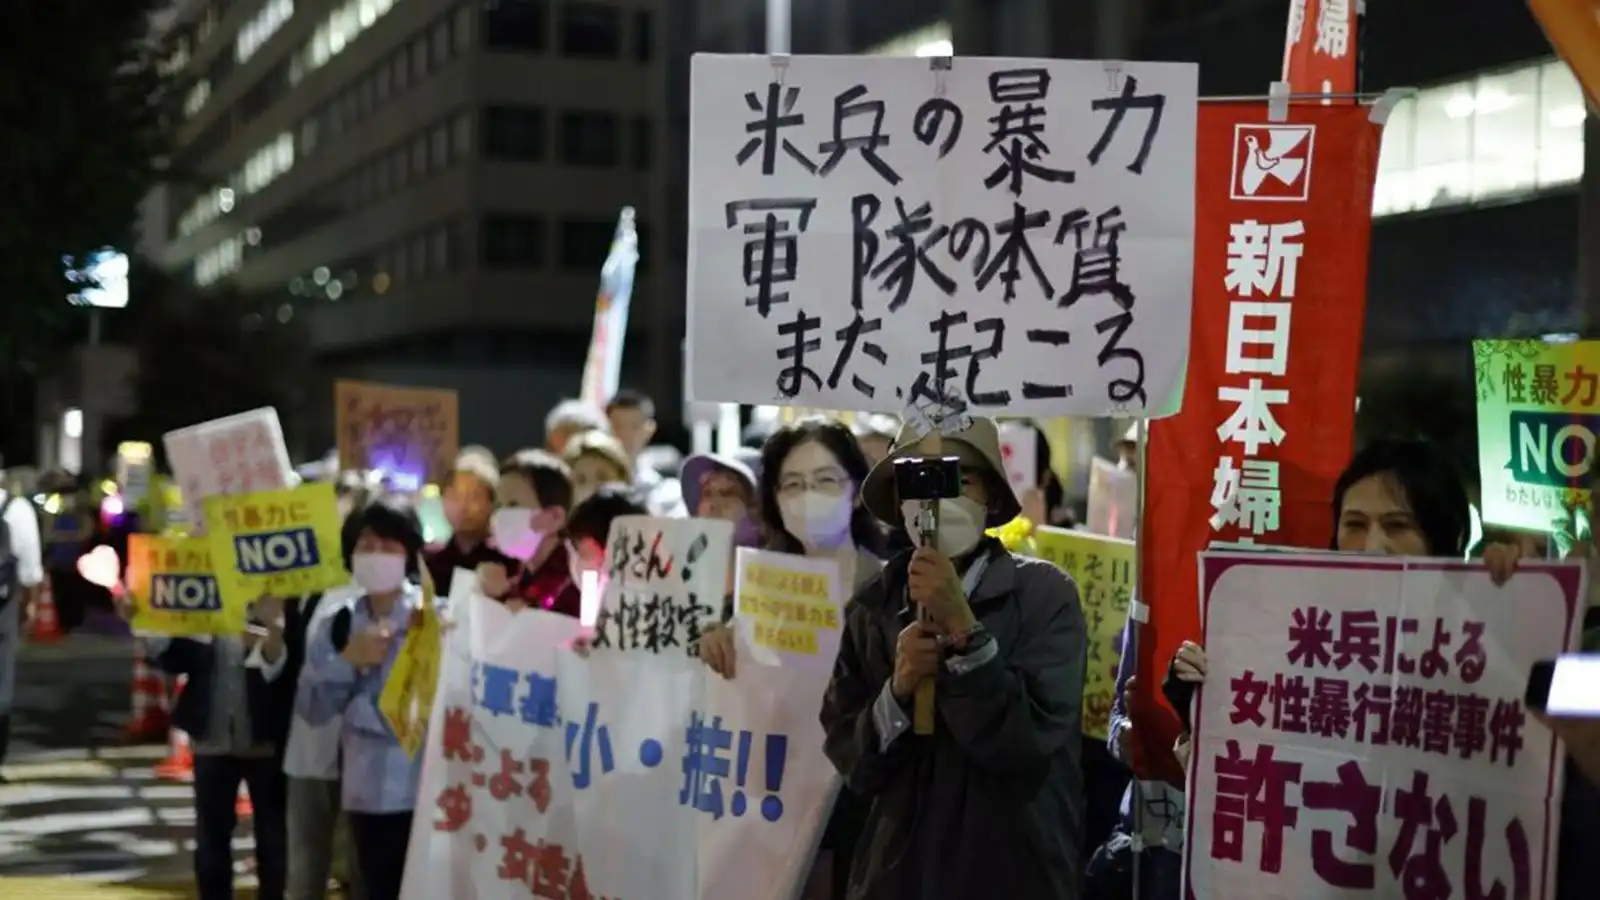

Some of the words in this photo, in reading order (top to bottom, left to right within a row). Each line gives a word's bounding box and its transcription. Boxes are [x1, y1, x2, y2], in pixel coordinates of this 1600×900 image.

[735, 67, 1166, 196] 米兵の暴力
[726, 194, 1135, 318] 軍隊の本質
[1208, 219, 1305, 549] 新日本婦
[1503, 364, 1599, 405] 性暴力
[155, 576, 215, 608] NO!
[238, 531, 312, 571] NO!
[1286, 606, 1487, 684] 米兵による
[1229, 669, 1526, 767] 女性暴行殺害事件
[1211, 739, 1532, 899] 許さない
